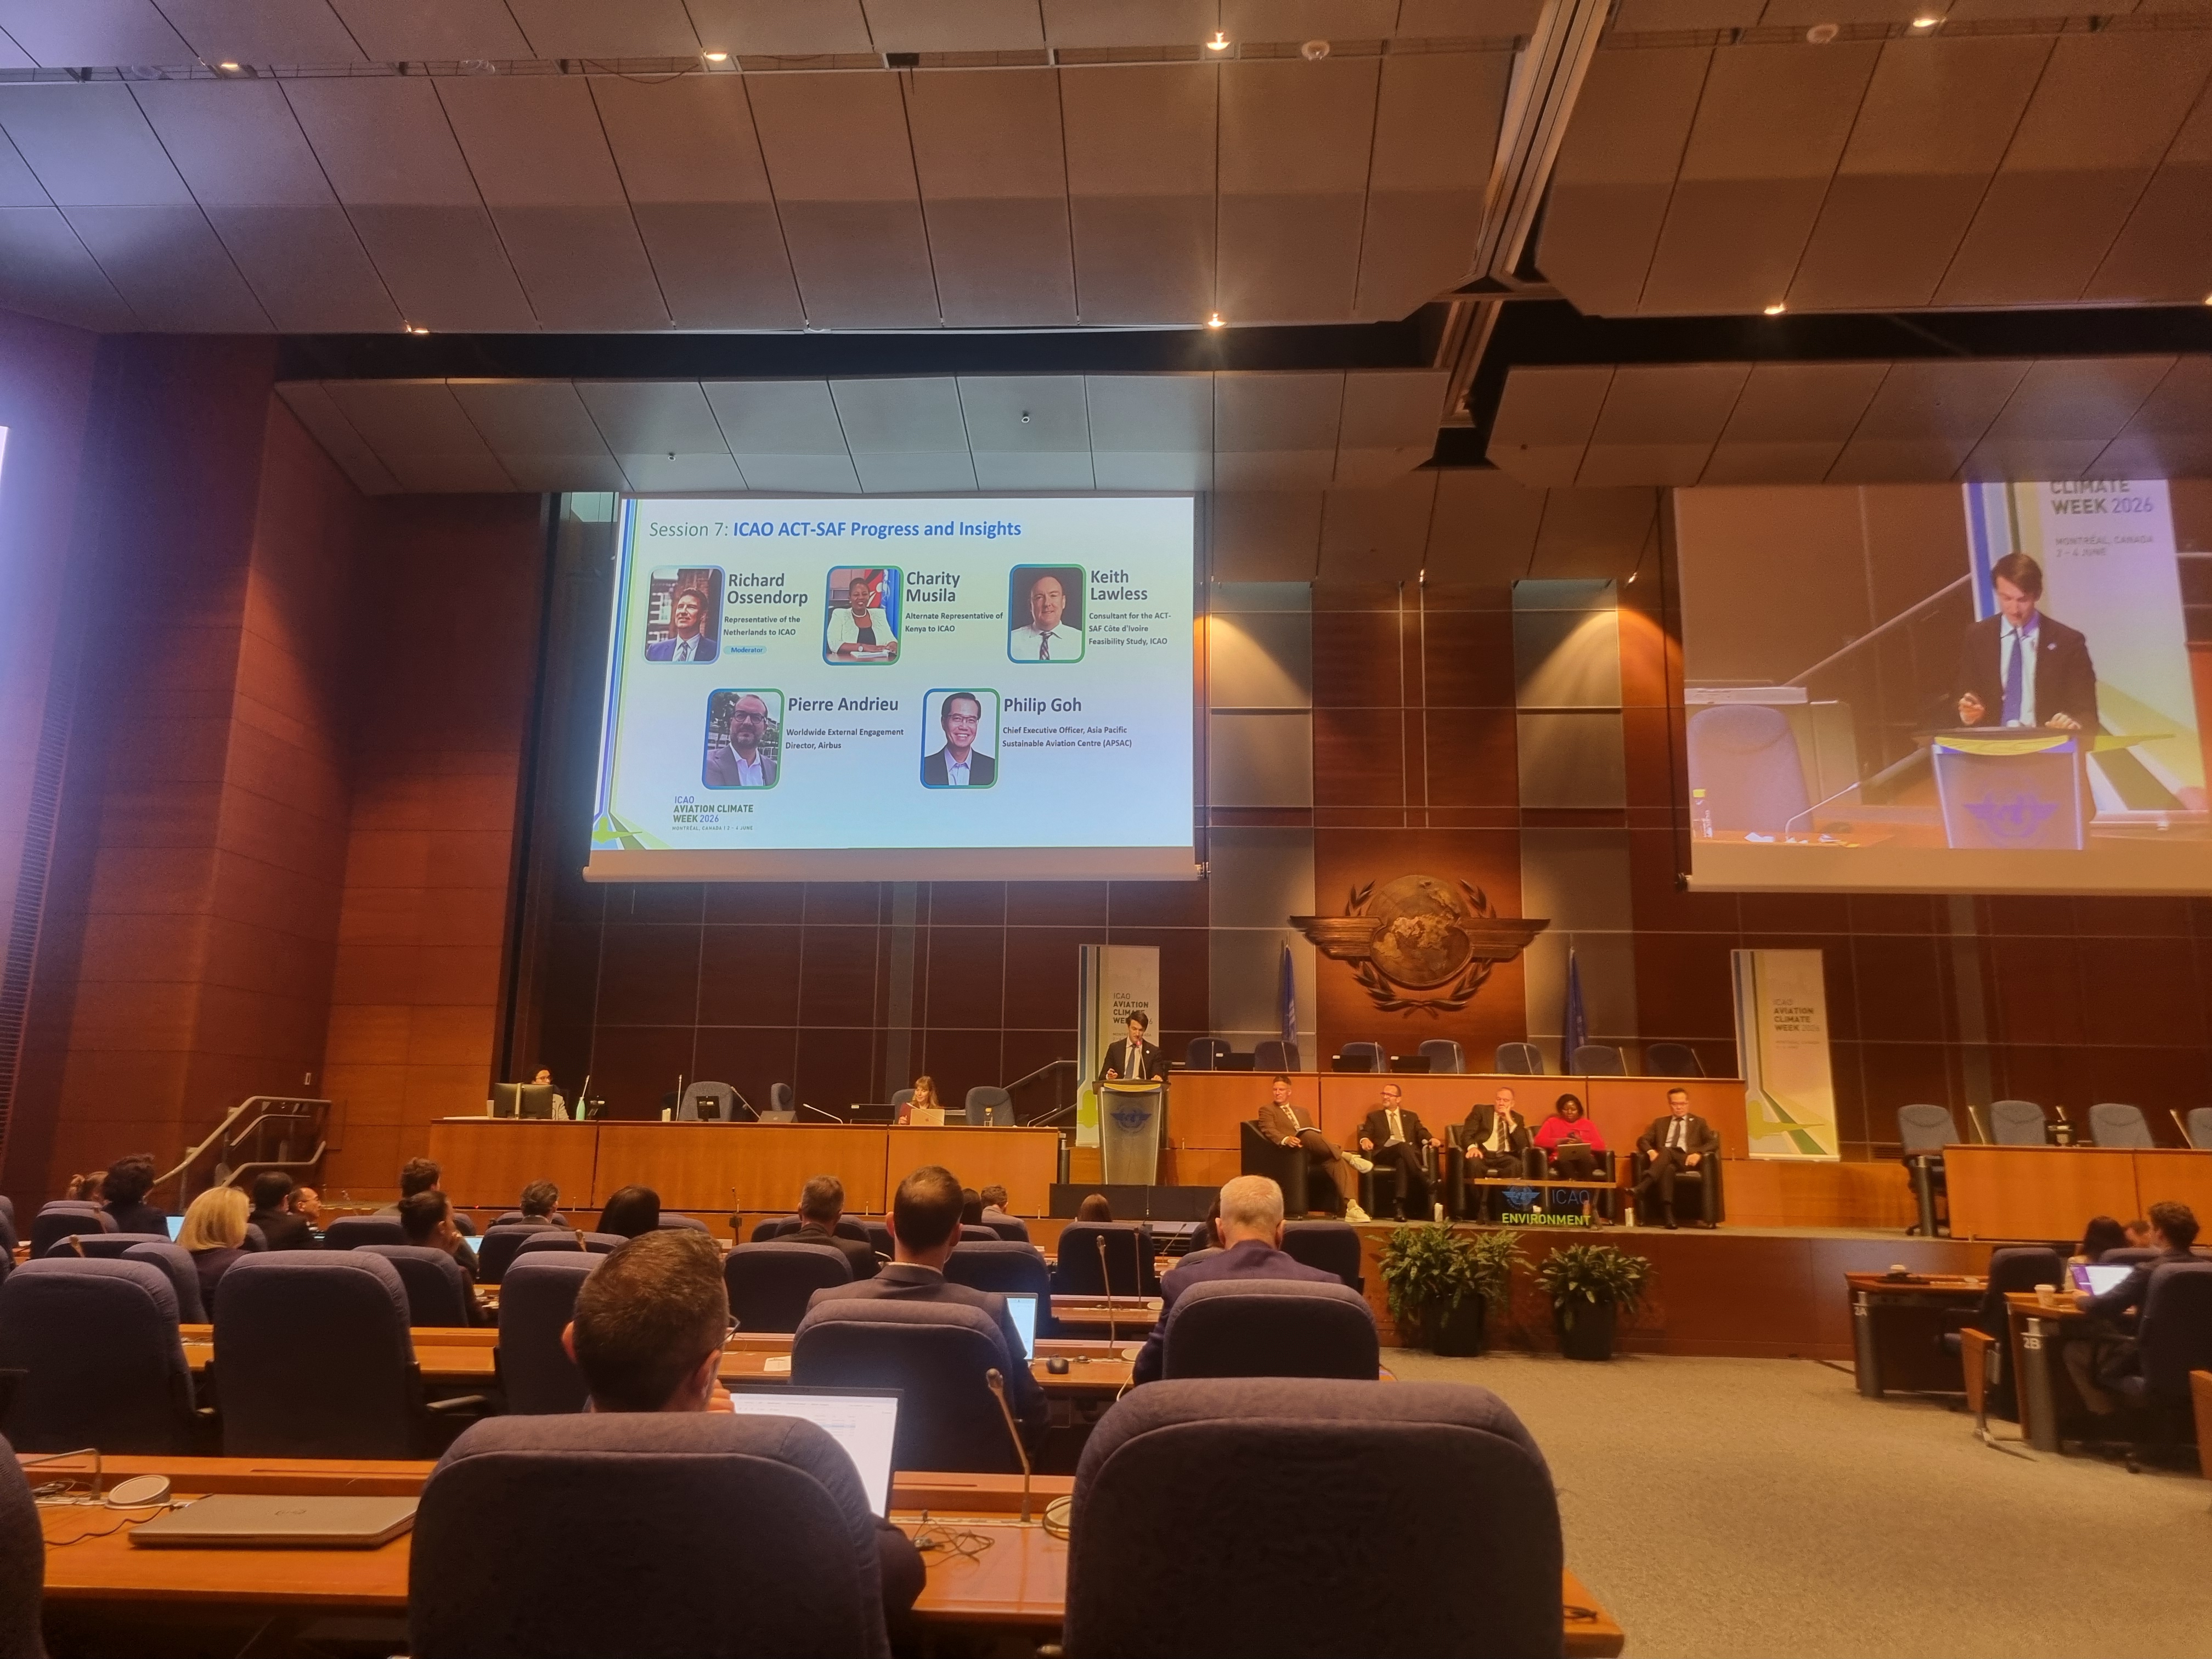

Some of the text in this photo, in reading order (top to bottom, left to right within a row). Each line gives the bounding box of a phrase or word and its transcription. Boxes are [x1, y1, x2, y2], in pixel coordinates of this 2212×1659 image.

[2051, 497, 2155, 515] WEEK 2026
[649, 521, 1021, 539] Session 7: ICAO ACT-SAF Progress and Insights
[729, 573, 785, 586] Richard
[906, 571, 961, 588] Charity
[1091, 569, 1128, 583] Keith
[727, 590, 808, 607] Ossendorp
[906, 588, 956, 602] Musila
[1091, 586, 1148, 600] Lawless
[724, 616, 777, 624] Representative
[941, 612, 994, 620] Representative
[905, 625, 926, 634] Kenya
[1088, 637, 1125, 646] Feasibility
[1126, 637, 1148, 646] Study,
[788, 696, 899, 711] Pierre Andrieu
[1004, 697, 1081, 715] Philip Goh
[859, 729, 904, 737] Engagement
[1059, 726, 1085, 735] Officer,
[785, 742, 816, 750] Director,
[1103, 740, 1132, 748] (APSAC)
[674, 795, 695, 804] ICAO
[673, 804, 754, 813] AVIATION CLIMATE
[699, 814, 719, 822] 2026
[1552, 1189, 1590, 1205] ICAO
[1502, 1212, 1591, 1226] ENVIRONMENT
[2023, 1337, 2041, 1350] 2B
